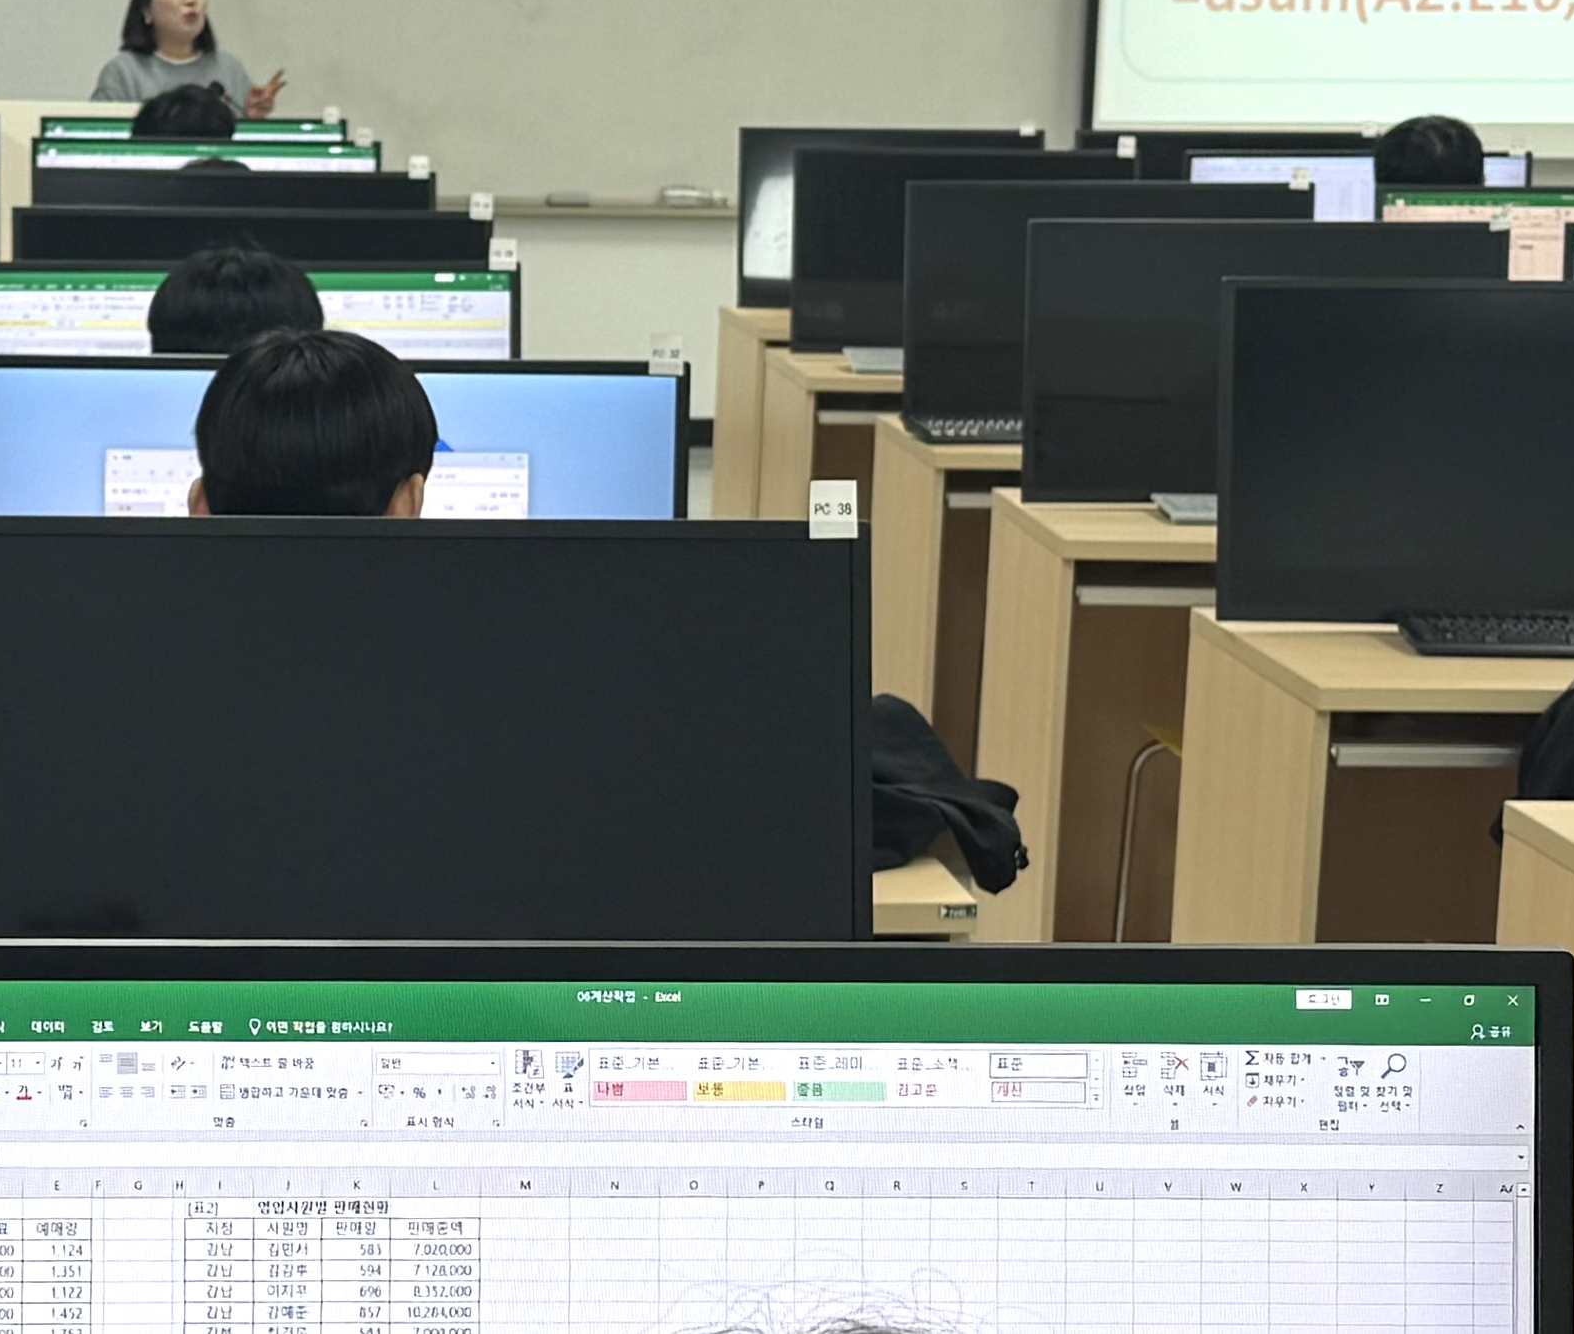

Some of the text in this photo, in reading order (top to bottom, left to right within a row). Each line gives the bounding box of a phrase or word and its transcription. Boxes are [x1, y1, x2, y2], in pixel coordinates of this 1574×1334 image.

[837, 502, 852, 515] 38
[655, 991, 681, 1002] Excel
[31, 1021, 65, 1033] 데이터
[140, 1021, 162, 1034] 보기
[54, 1181, 60, 1191] E
[134, 1181, 142, 1190] G
[354, 1181, 361, 1190] K
[433, 1181, 440, 1190] L
[520, 1181, 531, 1190] M
[610, 1181, 619, 1190] N
[689, 1181, 698, 1190] O
[1230, 1181, 1242, 1192] W
[1300, 1182, 1308, 1192] X
[1436, 1183, 1443, 1193] Z
